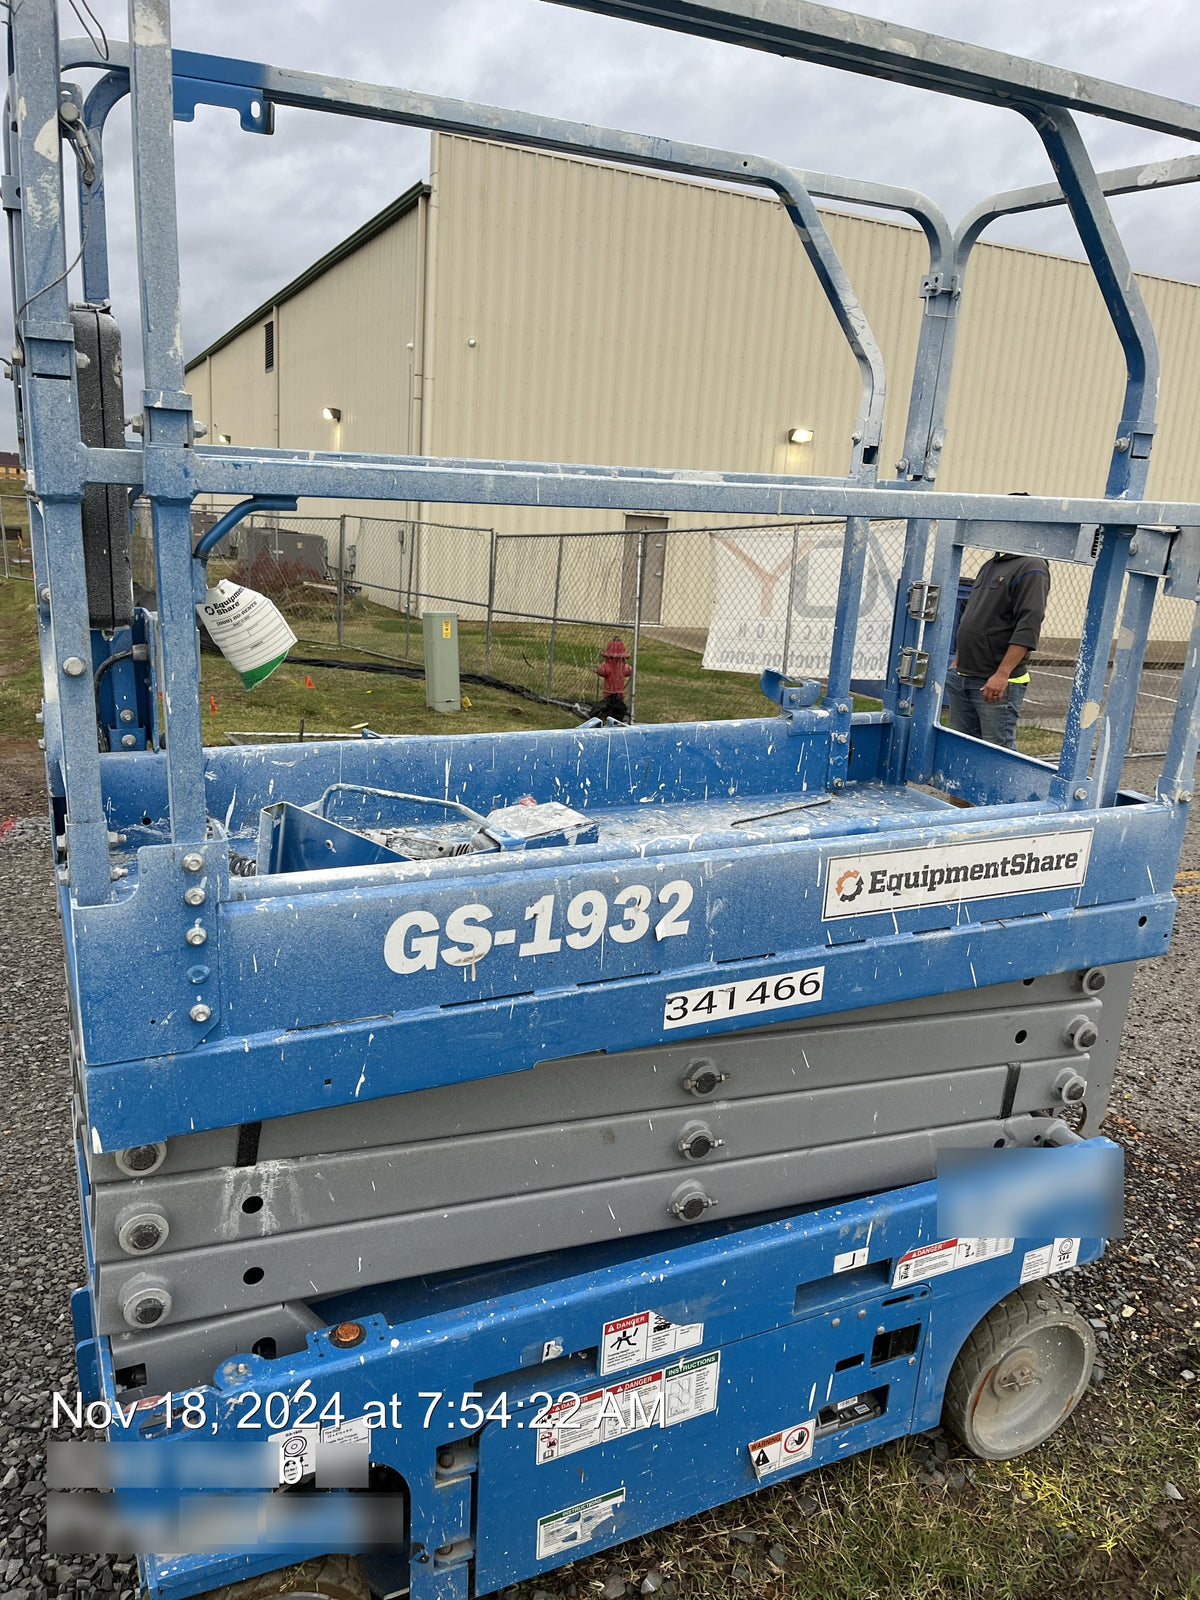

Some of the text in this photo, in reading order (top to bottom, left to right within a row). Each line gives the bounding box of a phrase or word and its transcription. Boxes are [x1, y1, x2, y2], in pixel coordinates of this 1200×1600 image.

[216, 602, 240, 615] Share
[868, 849, 1079, 895] EquipmentShare
[384, 879, 694, 975] GS-1932
[666, 972, 820, 1022] 341466
[917, 1244, 943, 1256] DANGER
[616, 1316, 645, 1329] DANGER
[625, 1376, 652, 1390] DANGER
[561, 1396, 589, 1409] DANER
[751, 1434, 782, 1450] WARNING
